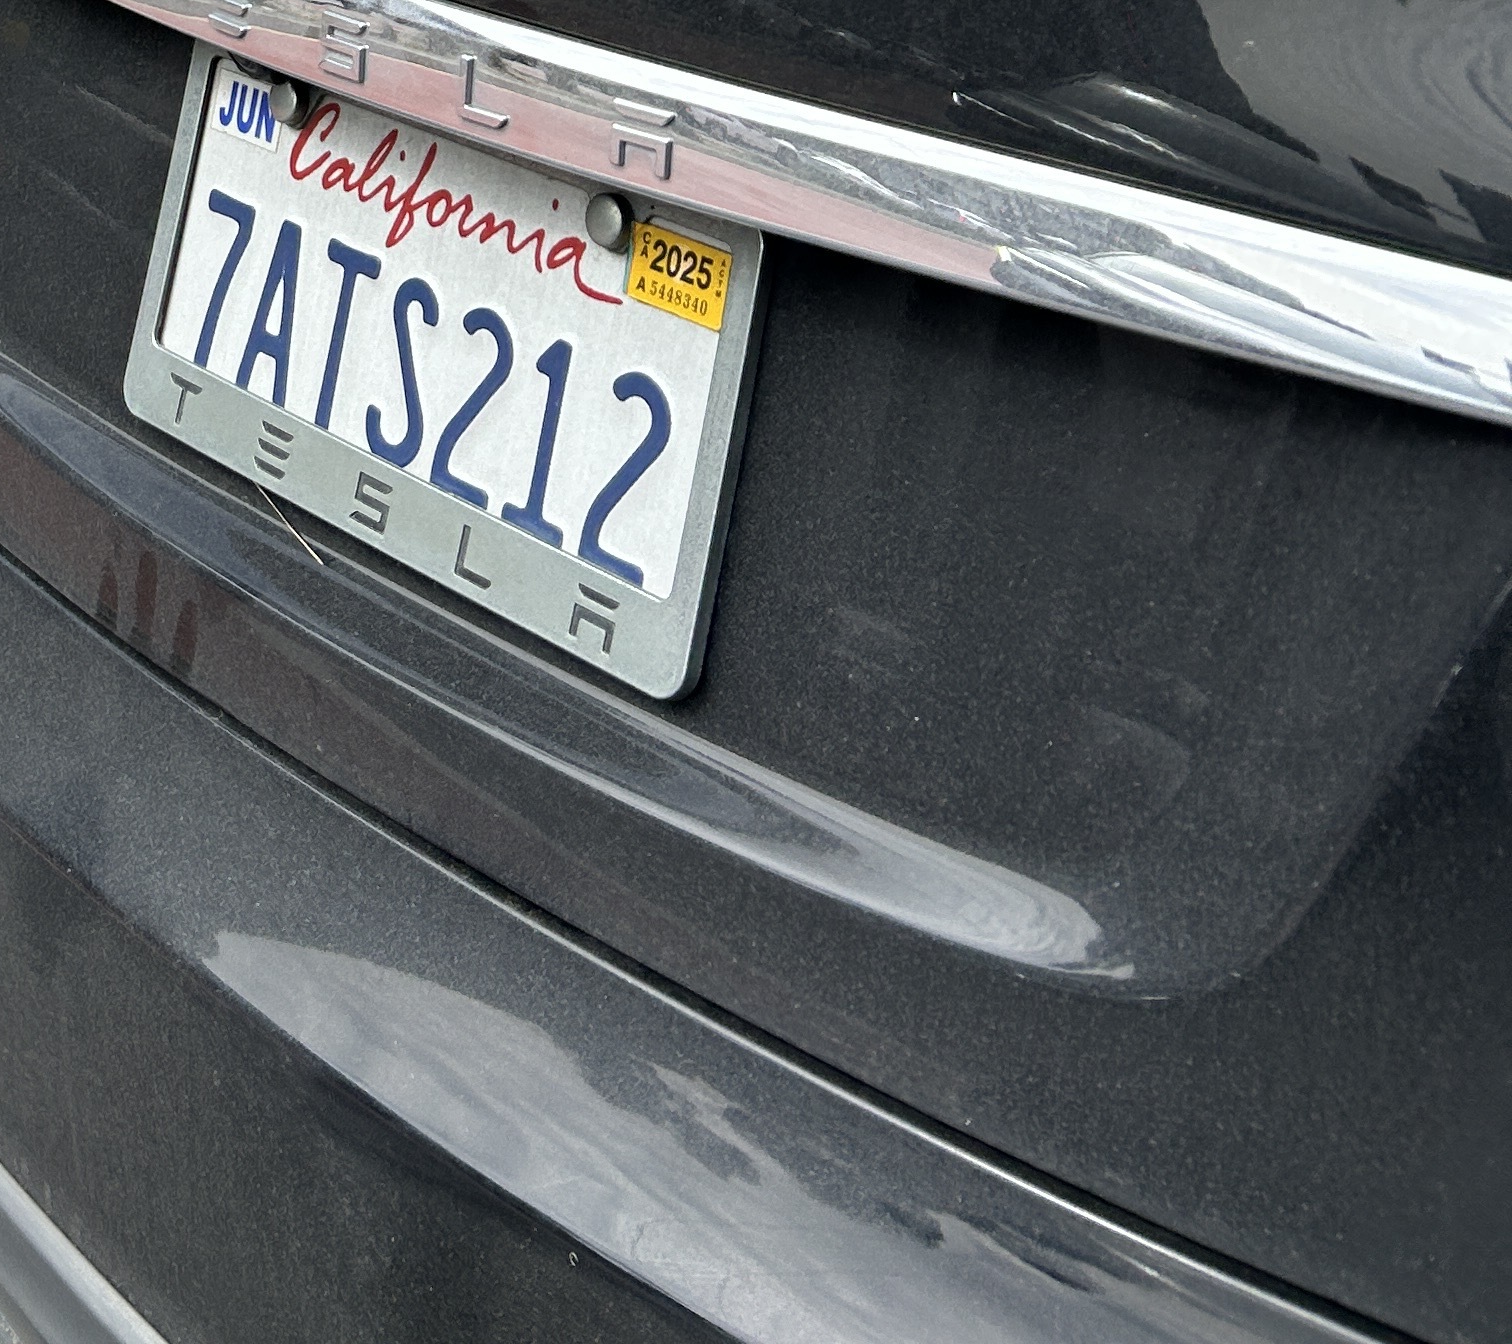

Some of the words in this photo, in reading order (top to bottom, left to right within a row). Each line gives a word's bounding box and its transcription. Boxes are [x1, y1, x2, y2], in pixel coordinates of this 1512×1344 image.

[219, 80, 275, 143] JUN
[290, 102, 623, 304] California
[649, 239, 714, 290] 2025
[194, 188, 672, 589] 7ATS212
[171, 372, 620, 655] TESLA
